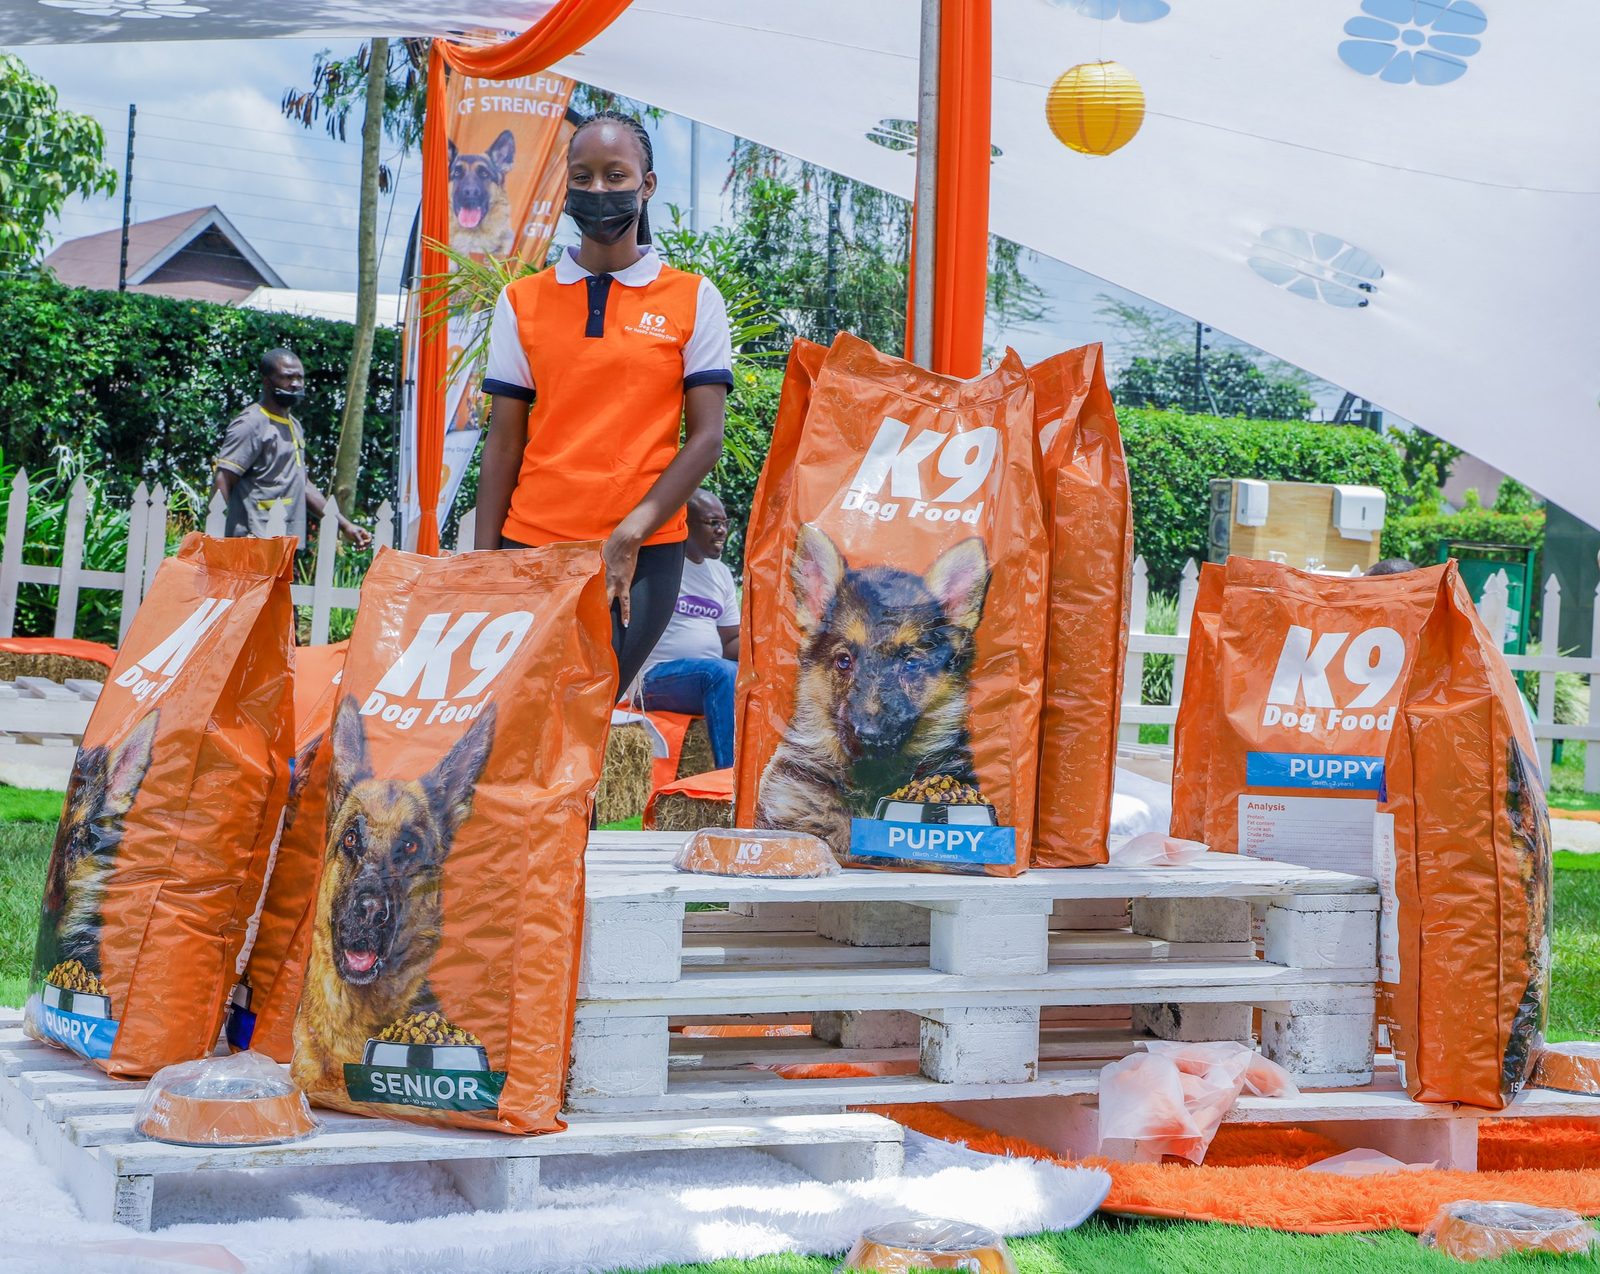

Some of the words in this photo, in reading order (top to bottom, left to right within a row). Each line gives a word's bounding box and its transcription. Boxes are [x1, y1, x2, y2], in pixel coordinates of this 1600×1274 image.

[640, 312, 666, 328] K9
[850, 416, 998, 503] K9
[840, 490, 900, 522] Dog
[908, 501, 984, 524] Food
[375, 610, 535, 700] K9
[1267, 624, 1406, 709] K9
[114, 664, 156, 702] Dog
[358, 691, 422, 729] Dog
[425, 691, 493, 725] Food
[1262, 704, 1316, 733] Dog
[1327, 706, 1397, 731] Food
[1290, 758, 1378, 780] PUPPY
[1247, 802, 1286, 811] Analysis
[736, 843, 763, 860] K9
[888, 827, 984, 852] PUPPY
[45, 1011, 98, 1045] PUPPY
[370, 1071, 479, 1101] SENIOR
